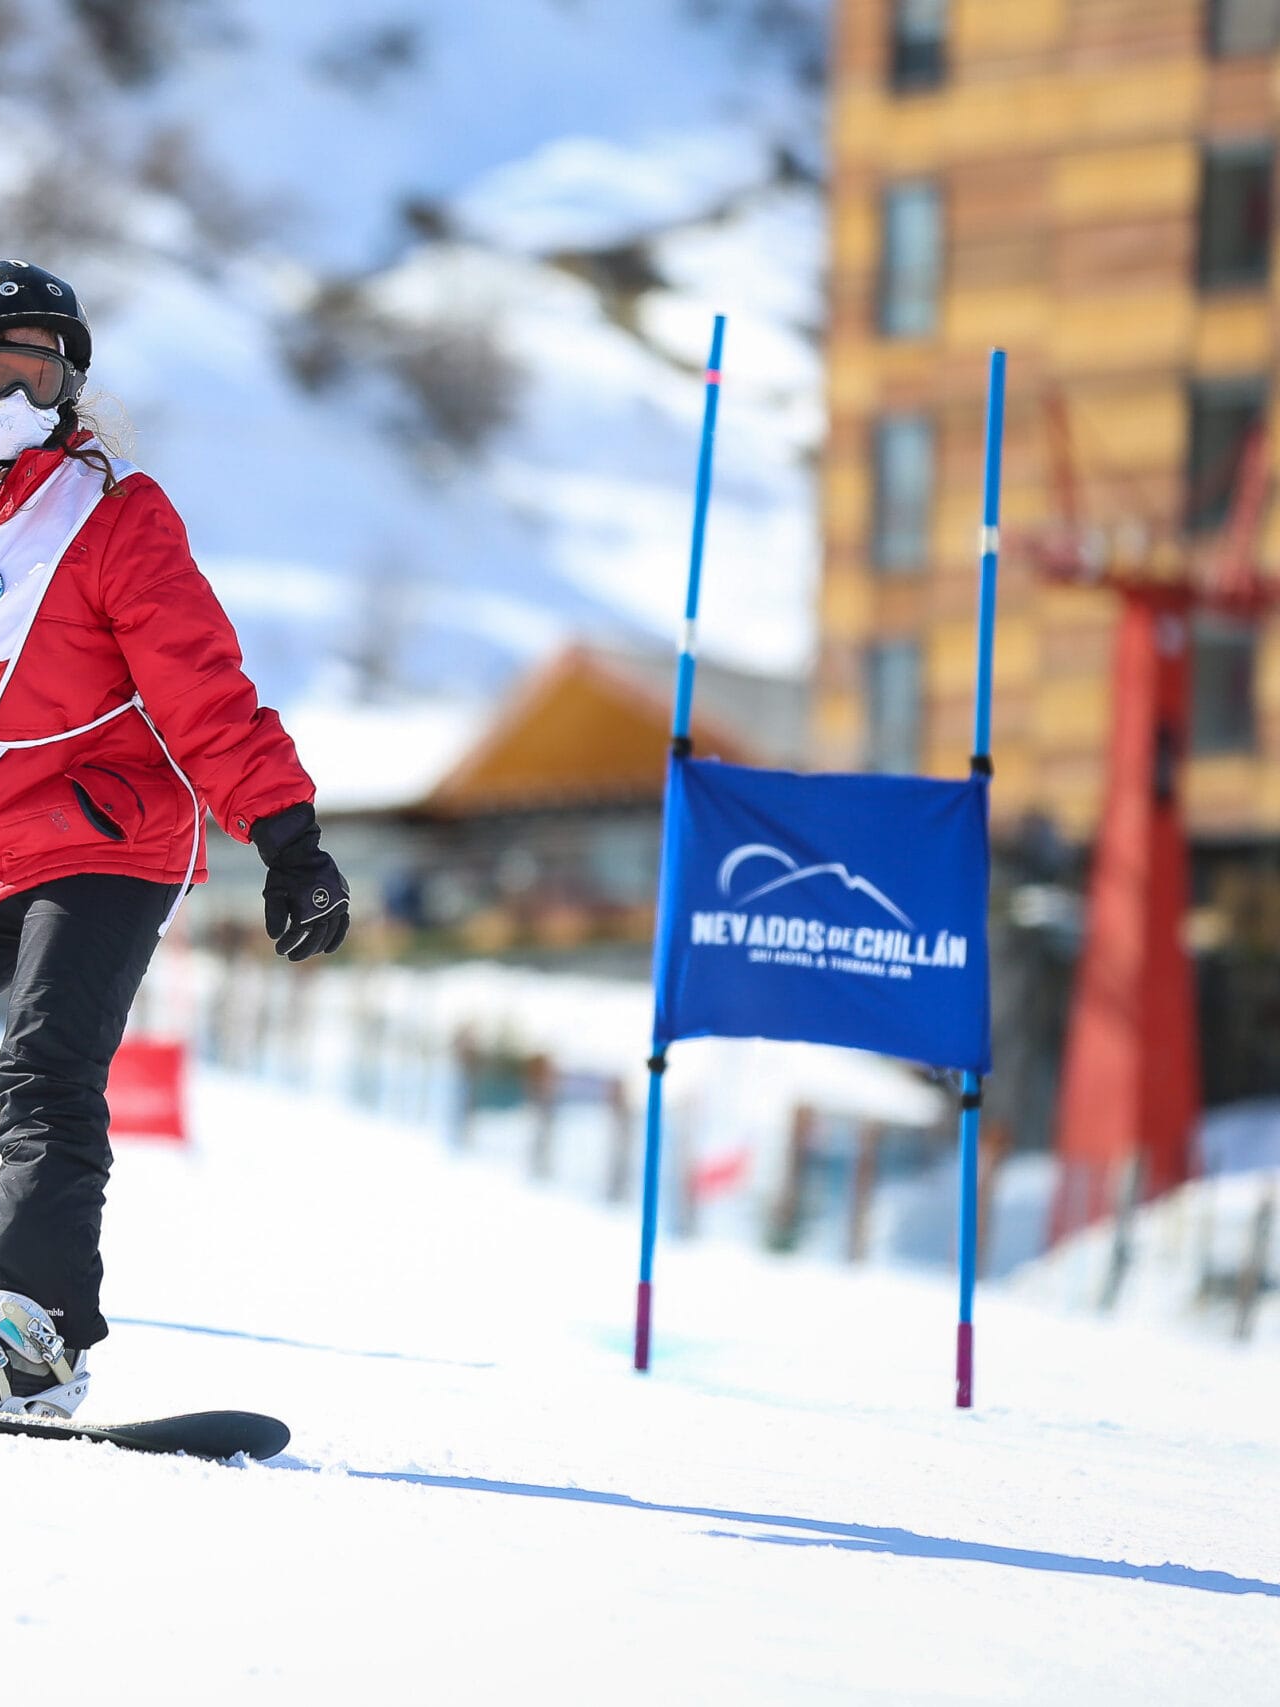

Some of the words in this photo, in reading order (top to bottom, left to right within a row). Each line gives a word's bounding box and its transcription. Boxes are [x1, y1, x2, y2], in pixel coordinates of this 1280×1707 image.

[691, 911, 825, 954] NEVADOS
[828, 926, 854, 951] DE
[855, 926, 967, 969] CHILLÁN
